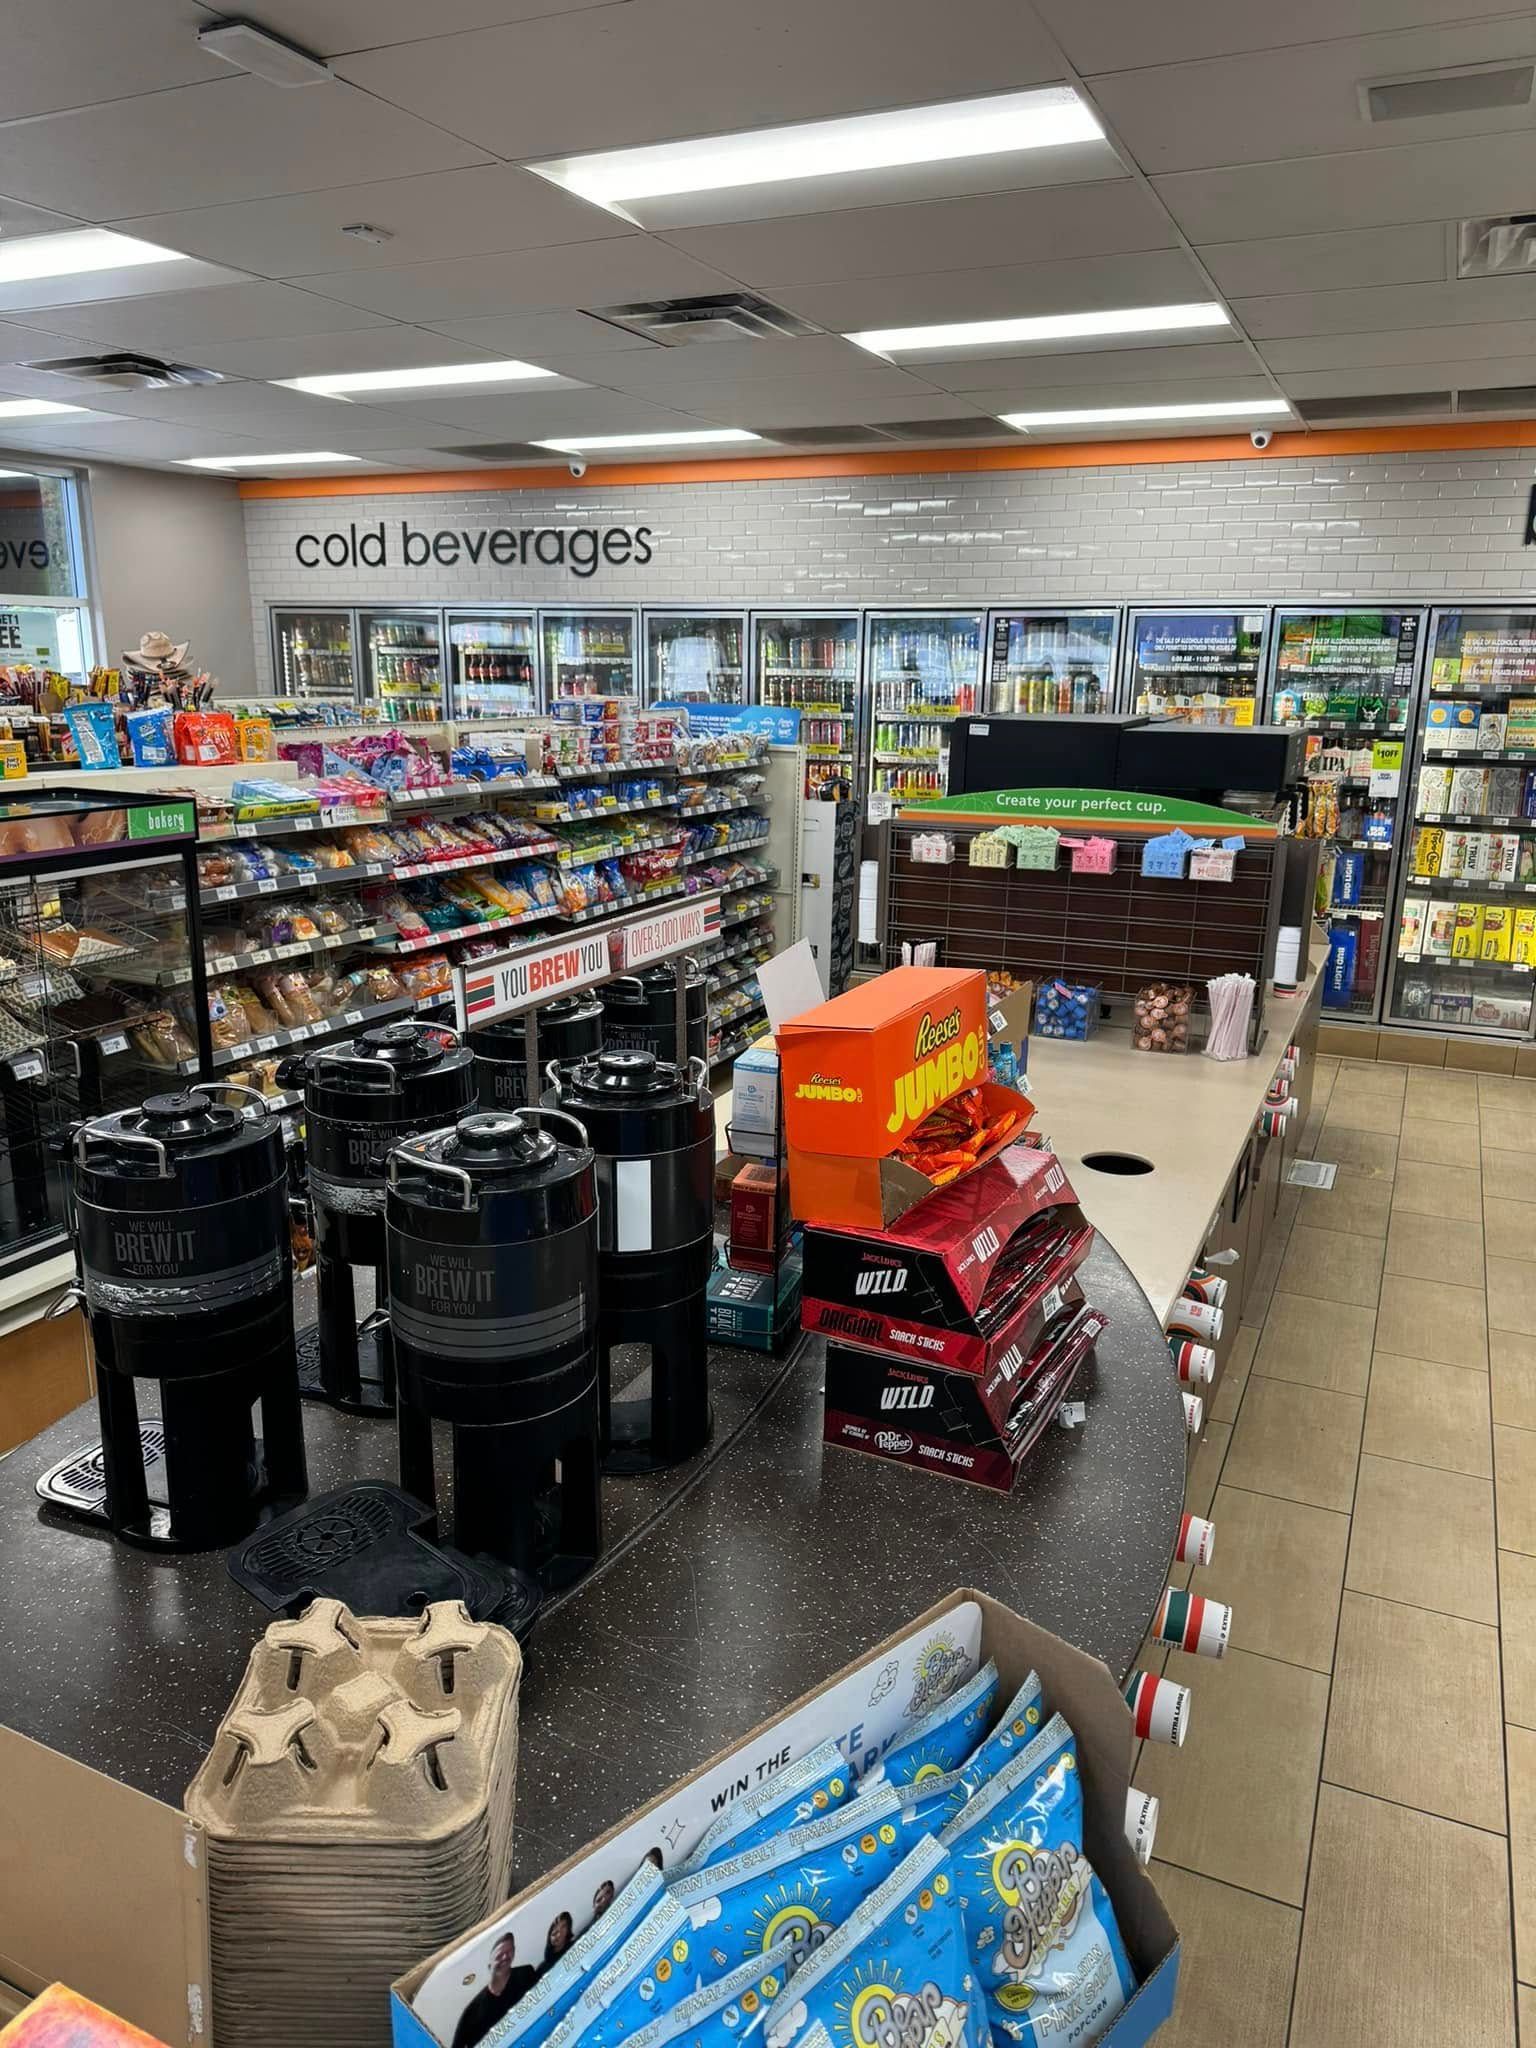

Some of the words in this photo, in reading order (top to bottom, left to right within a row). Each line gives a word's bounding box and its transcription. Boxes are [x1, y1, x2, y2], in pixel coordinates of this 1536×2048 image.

[296, 521, 387, 567] cold
[402, 521, 652, 578] beverages
[1324, 757, 1345, 772] IPA
[996, 794, 1041, 807] Create
[1045, 797, 1078, 811] your
[1081, 798, 1132, 812] perfect
[1136, 800, 1167, 815] cup.
[149, 810, 185, 832] bakery
[1344, 858, 1353, 884] LIGHT
[1467, 845, 1478, 870] TRULY
[1504, 847, 1515, 873] TRULY
[631, 930, 653, 958] OVER
[653, 921, 679, 952] 3,000
[678, 910, 701, 942] WAYS
[501, 967, 529, 1001] YOU
[529, 950, 580, 992] BREW
[580, 941, 603, 974] YOU
[1337, 947, 1345, 966] BUD
[1333, 965, 1343, 992] LIGHT
[914, 1006, 961, 1061] Reese's
[795, 1083, 857, 1103] JUMBO
[887, 1031, 979, 1133] JUMBO
[348, 1139, 383, 1165] BRE
[1044, 1163, 1065, 1195] WILD
[129, 1220, 146, 1233] WE
[147, 1219, 174, 1233] WILL
[114, 1231, 172, 1264] BREW
[176, 1230, 196, 1261] IT
[971, 1226, 1000, 1264] WILD
[133, 1264, 155, 1276] FOR
[154, 1263, 179, 1275] YOU
[430, 1253, 447, 1268] WE
[447, 1255, 474, 1270] WILL
[415, 1263, 471, 1302] BREW
[475, 1270, 495, 1303] IT
[719, 1276, 741, 1297] TEA
[730, 1277, 758, 1301] BLACK
[431, 1299, 451, 1313] FOR
[451, 1302, 476, 1316] YOU
[717, 1307, 732, 1337] BLACK
[819, 1307, 886, 1342] ORIGINAL
[889, 1329, 916, 1345] SNACK
[916, 1334, 946, 1352] STICKS
[998, 1343, 1023, 1382] WILD
[877, 1432, 912, 1451] Pepper
[887, 1431, 901, 1442] Dr
[918, 1444, 946, 1460] SNACK
[945, 1450, 975, 1468] STICKS
[1174, 1691, 1184, 1715] LARGE
[1172, 1714, 1180, 1741] EXTRA
[711, 1775, 750, 1813] WIN
[756, 1745, 792, 1781] THE
[705, 1858, 741, 1887] PINK
[741, 1842, 778, 1869] SALT
[789, 1802, 870, 1847] HIMALAYAN
[1001, 1841, 1078, 1901] Bear
[1003, 1876, 1066, 1971] Happy
[516, 1976, 553, 2018] SALT
[560, 1892, 638, 1973] HIMALAYAN
[582, 1927, 657, 2010] HIMALAYAN
[1046, 1943, 1105, 2005] HIMALAYAN
[674, 1962, 764, 2023] HIMALAYAN
[1038, 1999, 1084, 2039] PINK
[1083, 1952, 1114, 2008] SALT
[859, 1979, 944, 2048] Bear
[1067, 1999, 1109, 2044] POPCORN
